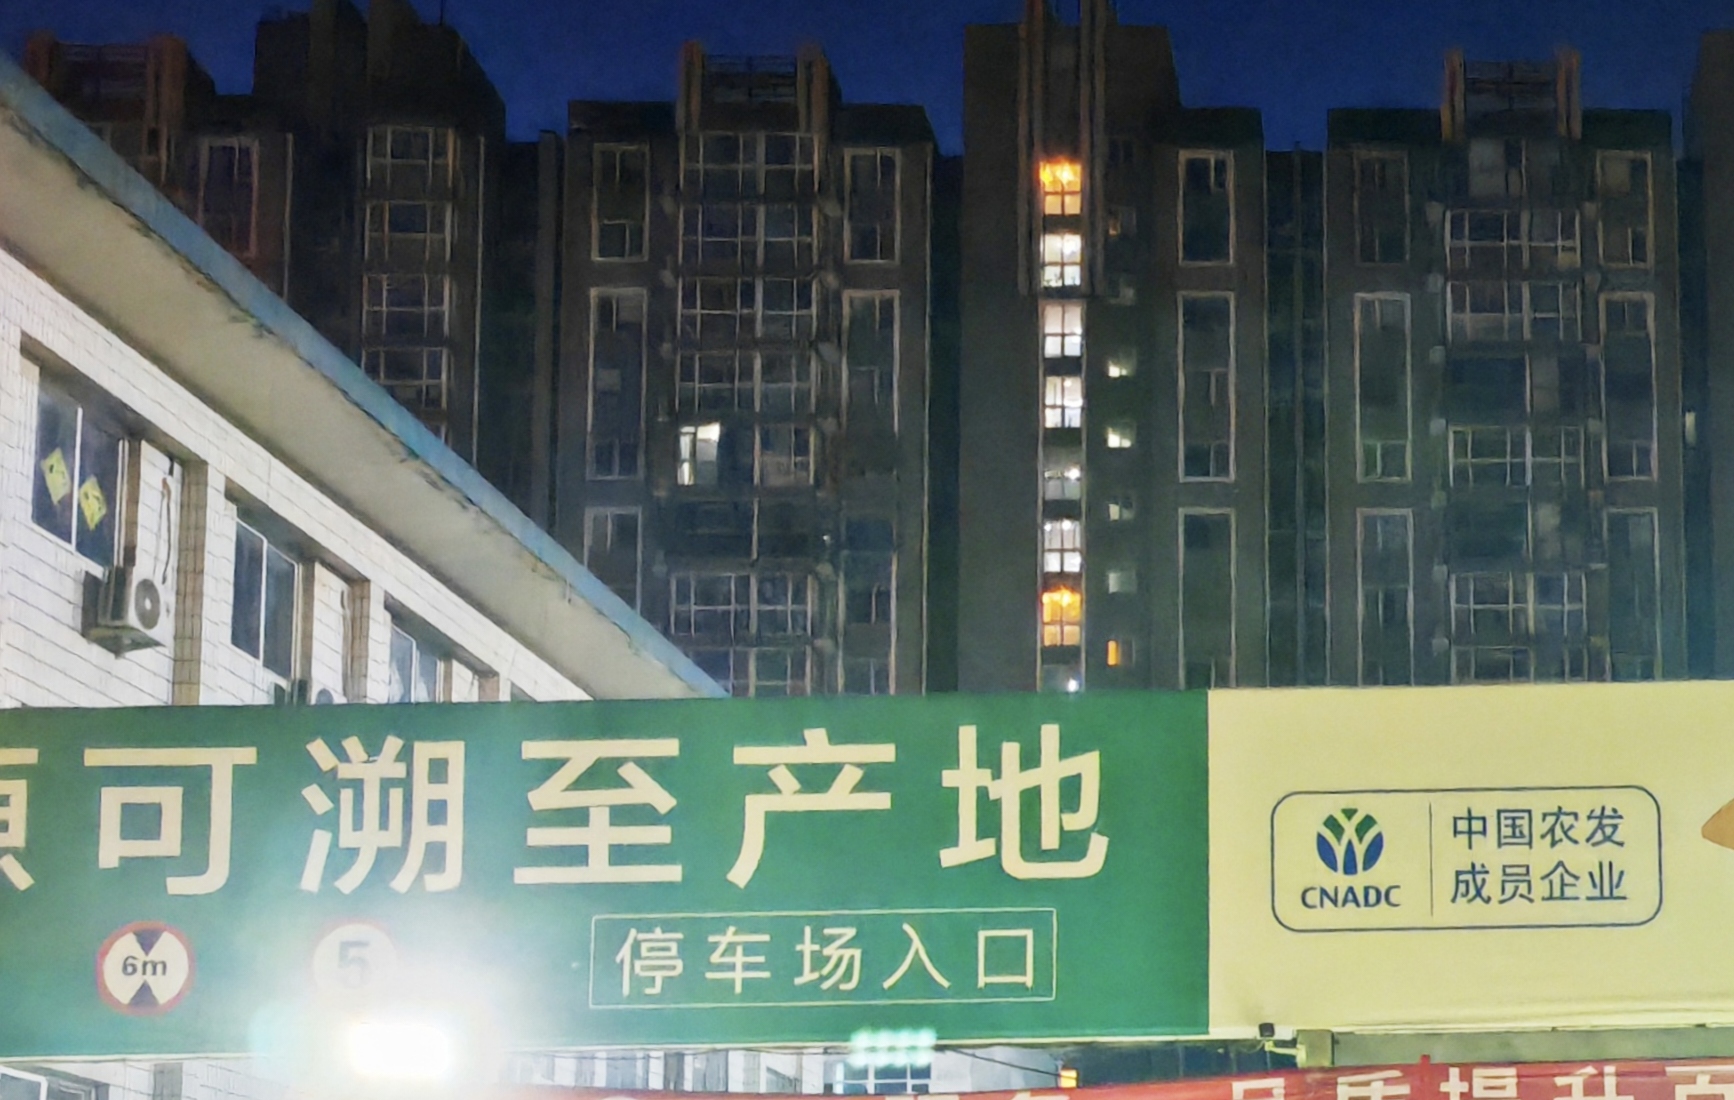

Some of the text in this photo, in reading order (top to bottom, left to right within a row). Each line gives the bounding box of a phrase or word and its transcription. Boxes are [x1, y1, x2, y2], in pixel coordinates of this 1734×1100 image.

[0, 724, 1109, 896] 可溯至产地
[1452, 805, 1625, 850] 中国农发
[1301, 885, 1401, 909] CNADC
[1450, 860, 1628, 904] 成员企业
[121, 956, 167, 977] 6m
[615, 924, 1034, 997] 停车场入口
